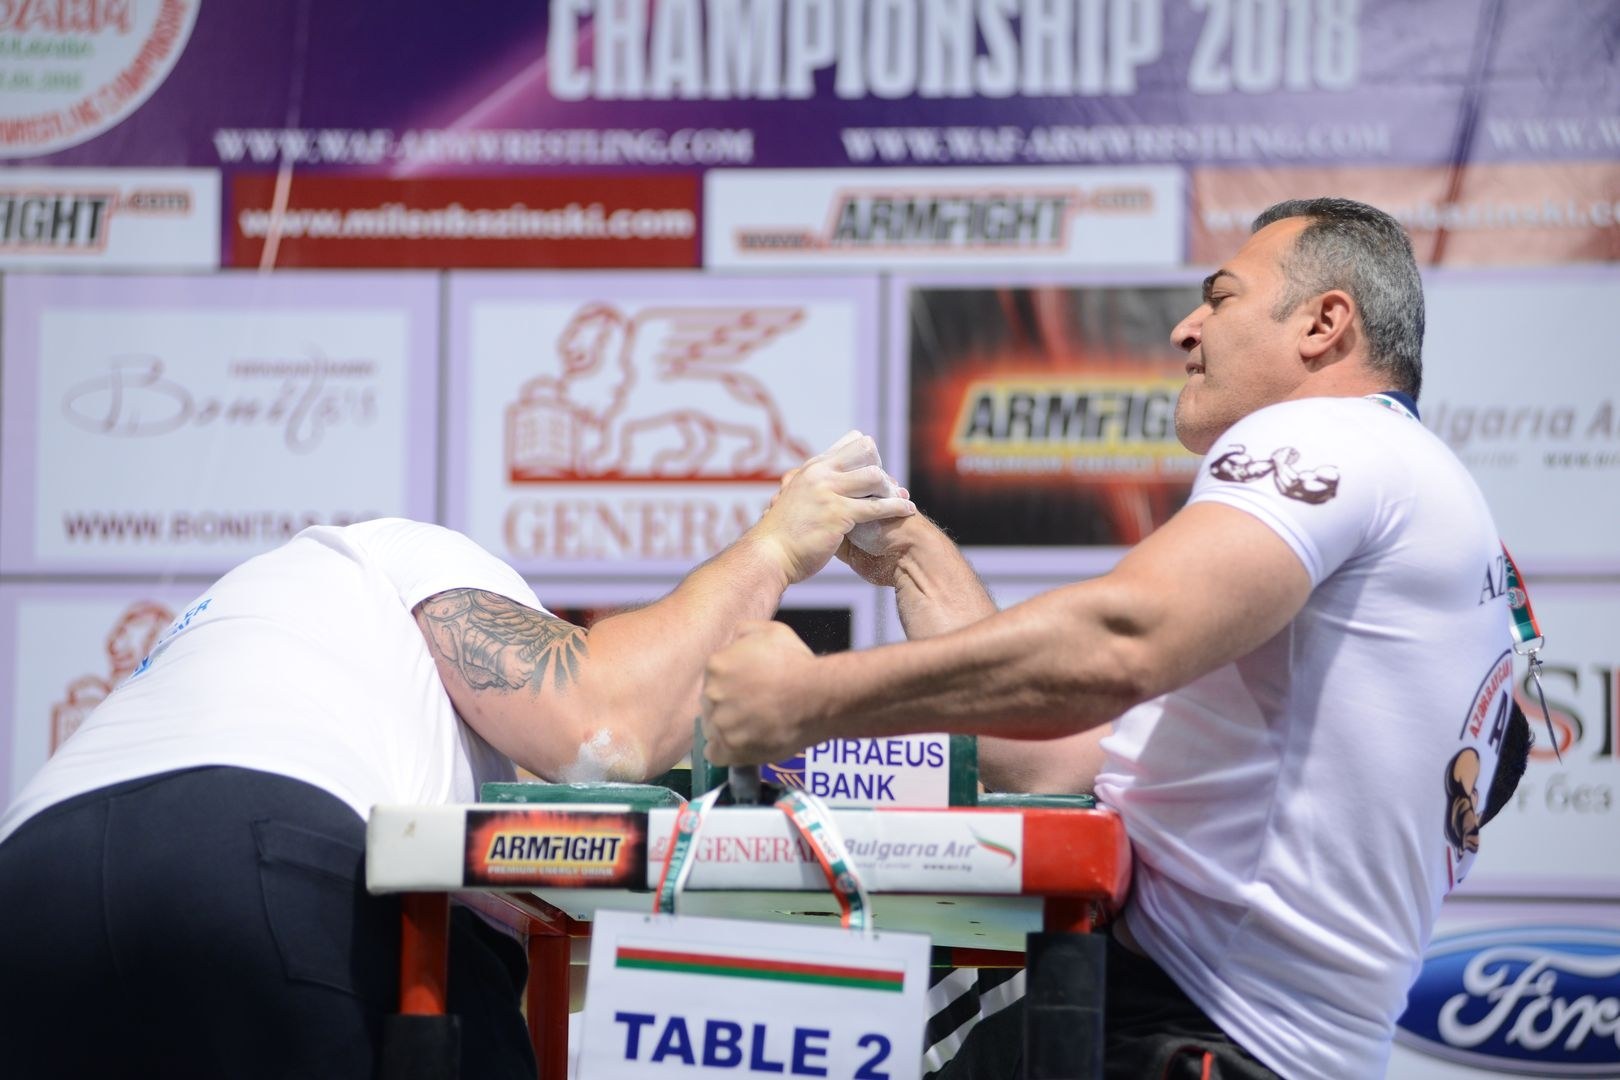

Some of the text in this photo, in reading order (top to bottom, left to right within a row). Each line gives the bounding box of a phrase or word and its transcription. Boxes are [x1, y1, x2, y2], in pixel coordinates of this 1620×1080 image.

[547, 0, 1358, 98] CHAMPIONSHIP 2018
[214, 128, 754, 164] WWW.WAF-ARMWRESTLING.COM
[842, 124, 1390, 162] WWW.WAF-ARMWRESTLING.COM
[962, 390, 1178, 440] ARMFIG
[813, 738, 944, 768] PIRAEUS
[811, 772, 895, 801] BANK
[490, 836, 621, 861] ARMFIGHT
[487, 865, 614, 877] PREMIUM ENERGY DRINK
[1437, 945, 1620, 1051] For
[614, 1010, 892, 1080] TABLE 2
